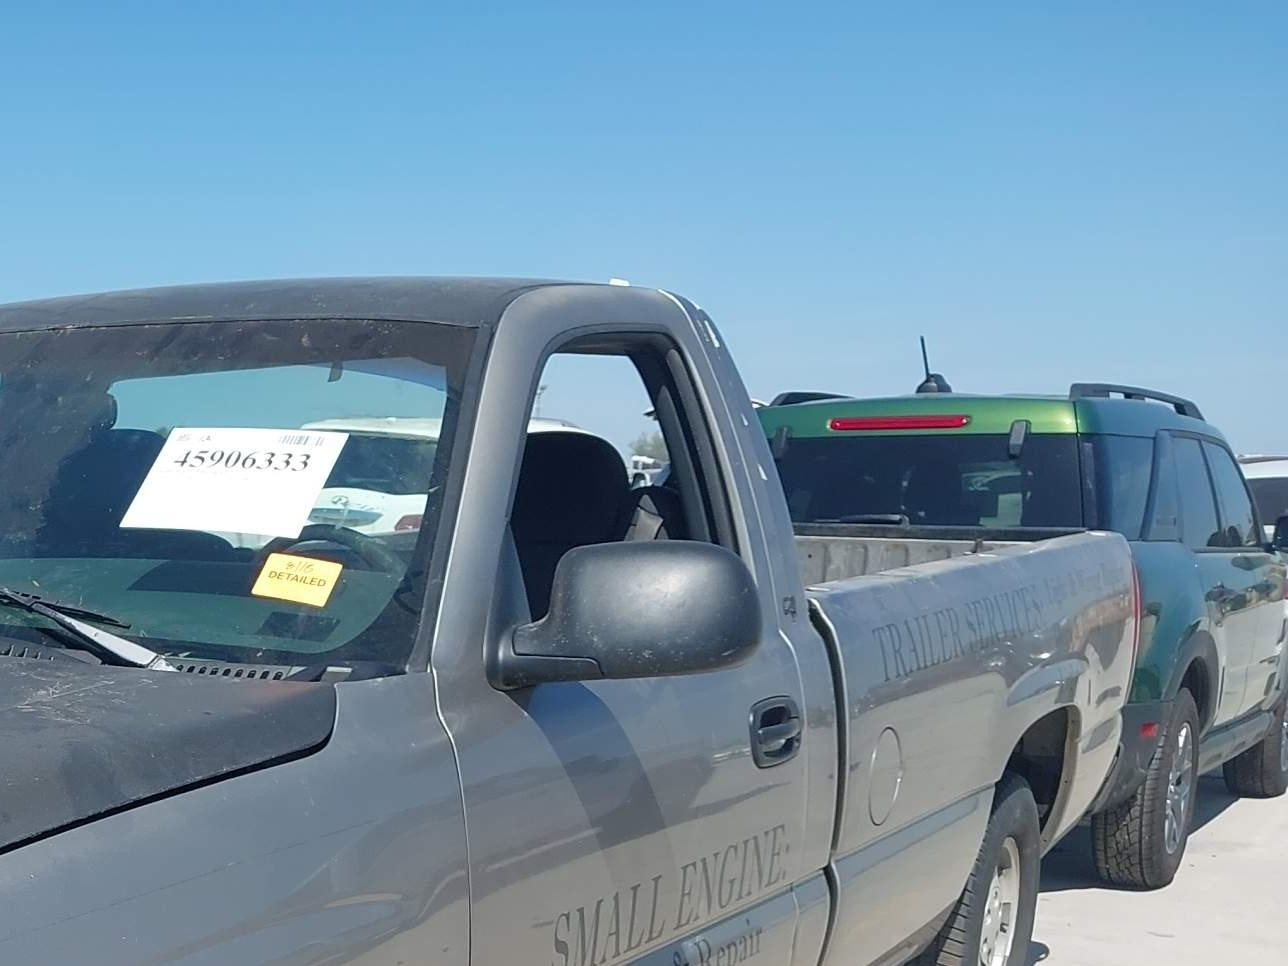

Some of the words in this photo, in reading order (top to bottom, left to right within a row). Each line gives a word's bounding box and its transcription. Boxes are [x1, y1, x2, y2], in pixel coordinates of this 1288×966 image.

[174, 449, 311, 472] 45906333
[268, 570, 327, 587] DETAILED
[872, 607, 965, 682] TRAILER
